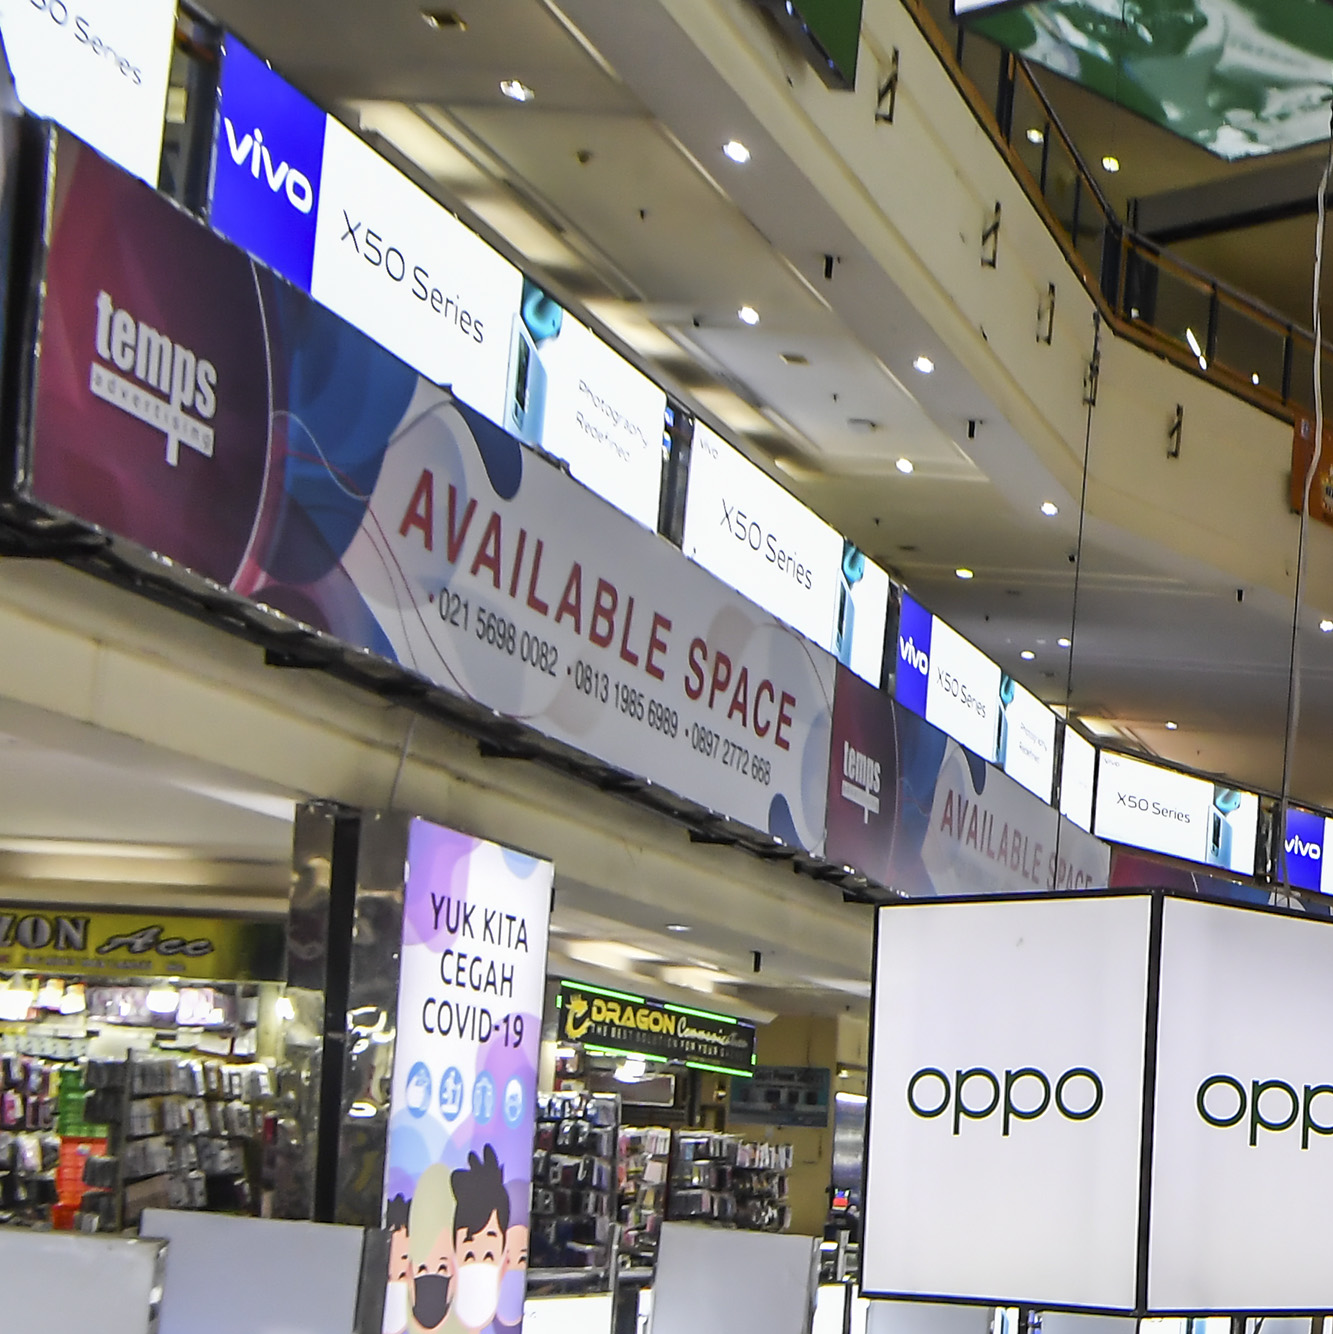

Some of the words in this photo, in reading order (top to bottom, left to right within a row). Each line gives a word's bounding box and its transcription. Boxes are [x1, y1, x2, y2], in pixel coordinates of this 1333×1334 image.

[74, 16, 142, 86] Series
[224, 116, 313, 215] vivo
[341, 209, 406, 284] X50
[410, 272, 486, 346] Series
[95, 289, 219, 466] temps
[721, 498, 763, 552] X50
[765, 533, 813, 590] Series
[400, 469, 672, 681] AVAILABLE
[684, 637, 796, 750] SPACE
[439, 588, 470, 632] 021
[476, 611, 516, 656] 5698
[520, 632, 559, 677] 0082
[575, 660, 610, 704] 0813
[614, 683, 645, 721] 1985
[648, 700, 679, 738] 6989
[692, 722, 720, 759] 0897
[722, 738, 749, 775] 2772
[751, 757, 771, 786] 668
[900, 637, 928, 676] vivo
[936, 667, 960, 699] X50
[960, 683, 987, 719] Series
[940, 790, 1041, 885] AVAILABLE
[1116, 792, 1149, 812] X50
[1152, 802, 1191, 824] Series
[1284, 835, 1321, 860] vivo
[431, 892, 476, 936] YUK
[483, 896, 529, 954] KITA
[440, 948, 514, 999] CEGAH
[422, 997, 524, 1049] COVID-19
[591, 998, 676, 1034] DRAGON
[907, 1066, 1104, 1137] oppo
